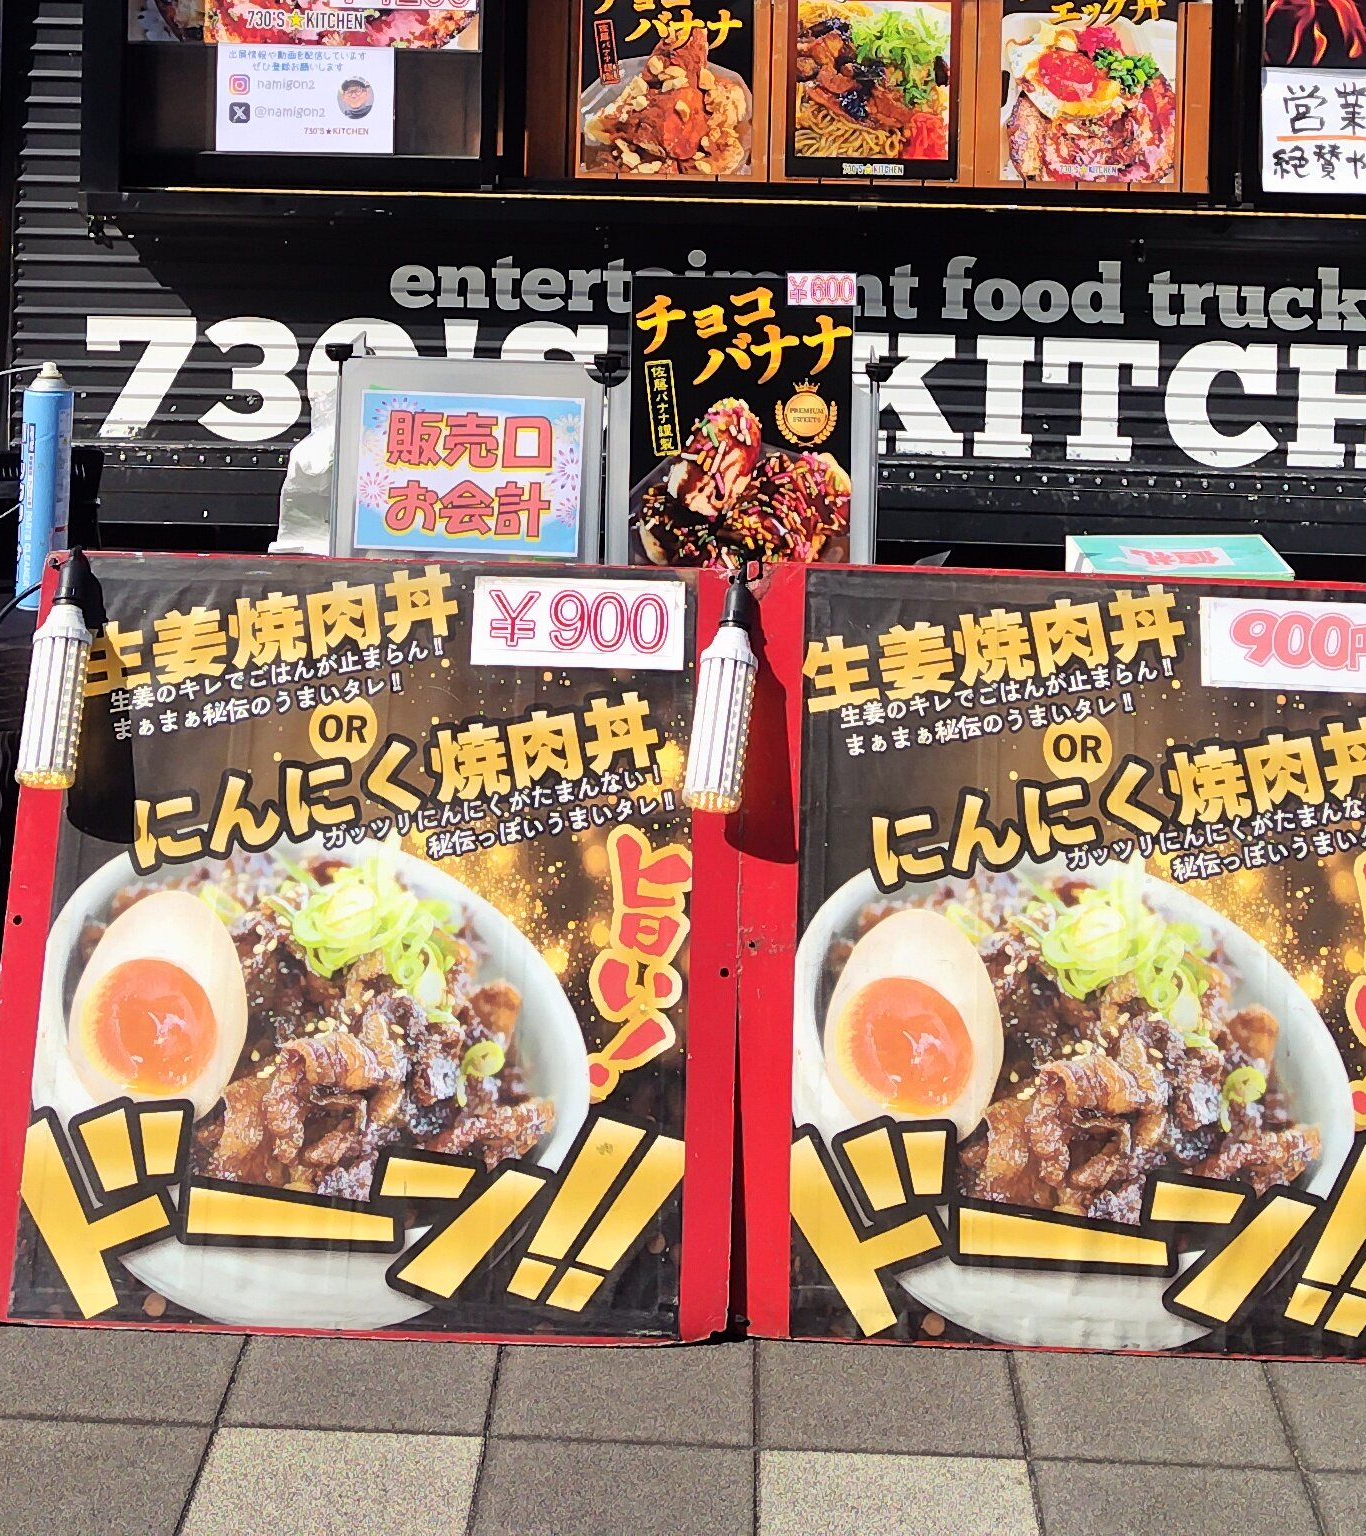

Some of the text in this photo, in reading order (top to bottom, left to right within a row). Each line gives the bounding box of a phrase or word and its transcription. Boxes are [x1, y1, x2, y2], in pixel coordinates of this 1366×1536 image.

[305, 12, 366, 31] KITCHEN
[624, 8, 743, 50] バナナ
[254, 105, 327, 119] @namigon2
[256, 78, 316, 91] namigon2
[331, 126, 370, 136] KITCHEN
[390, 250, 919, 320] entertnt
[940, 256, 1125, 325] food
[636, 286, 776, 354] チョコ
[692, 315, 853, 385] バナナ
[386, 409, 553, 468] 販売口
[384, 478, 551, 539] お会計
[83, 565, 459, 698] 生姜焼肉丼
[802, 583, 1186, 714] 生姜焼肉丼
[318, 713, 367, 744] OR
[1052, 733, 1103, 764] OR
[135, 691, 660, 869] にんにく焼肉丼
